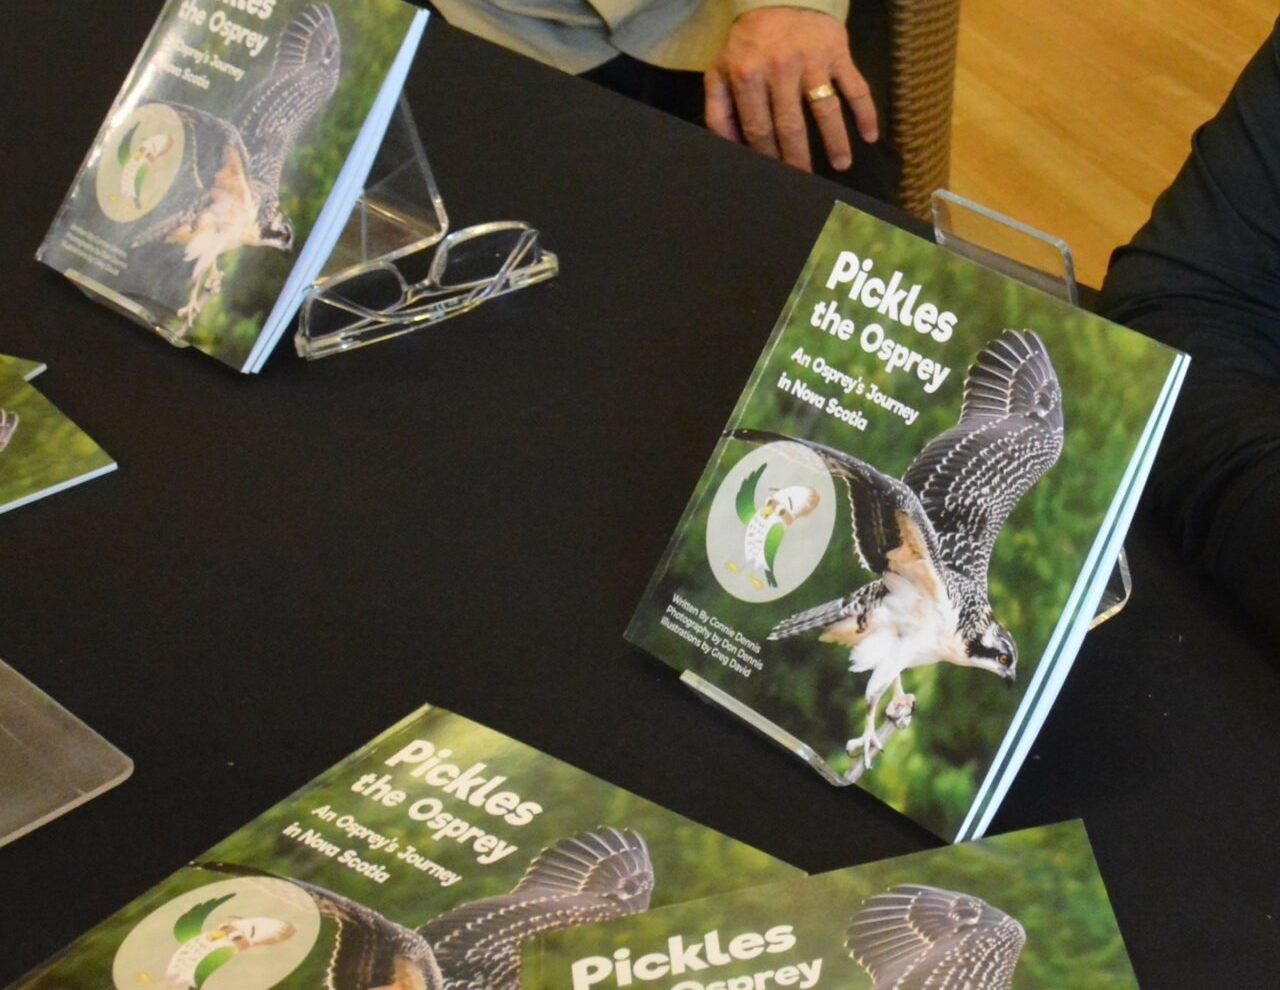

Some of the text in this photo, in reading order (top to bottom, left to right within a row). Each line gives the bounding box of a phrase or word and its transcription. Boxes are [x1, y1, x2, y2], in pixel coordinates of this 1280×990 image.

[208, 10, 270, 57] Osprey
[825, 250, 959, 343] Pickles
[810, 300, 951, 394] the Osprey
[777, 371, 869, 432] in Nova Scotia
[791, 347, 920, 426] An Osprey's Journey
[660, 615, 752, 678] Illustrations by Greg David
[666, 604, 764, 671] Photography by Don Dennis
[672, 593, 762, 654] Written By Connie Dennis
[384, 739, 543, 826] Pickles
[312, 805, 463, 887] An Osprey's Journey
[351, 772, 518, 865] the Osprey
[282, 821, 391, 884] in Nova Scotia
[571, 924, 797, 990] Pickles
